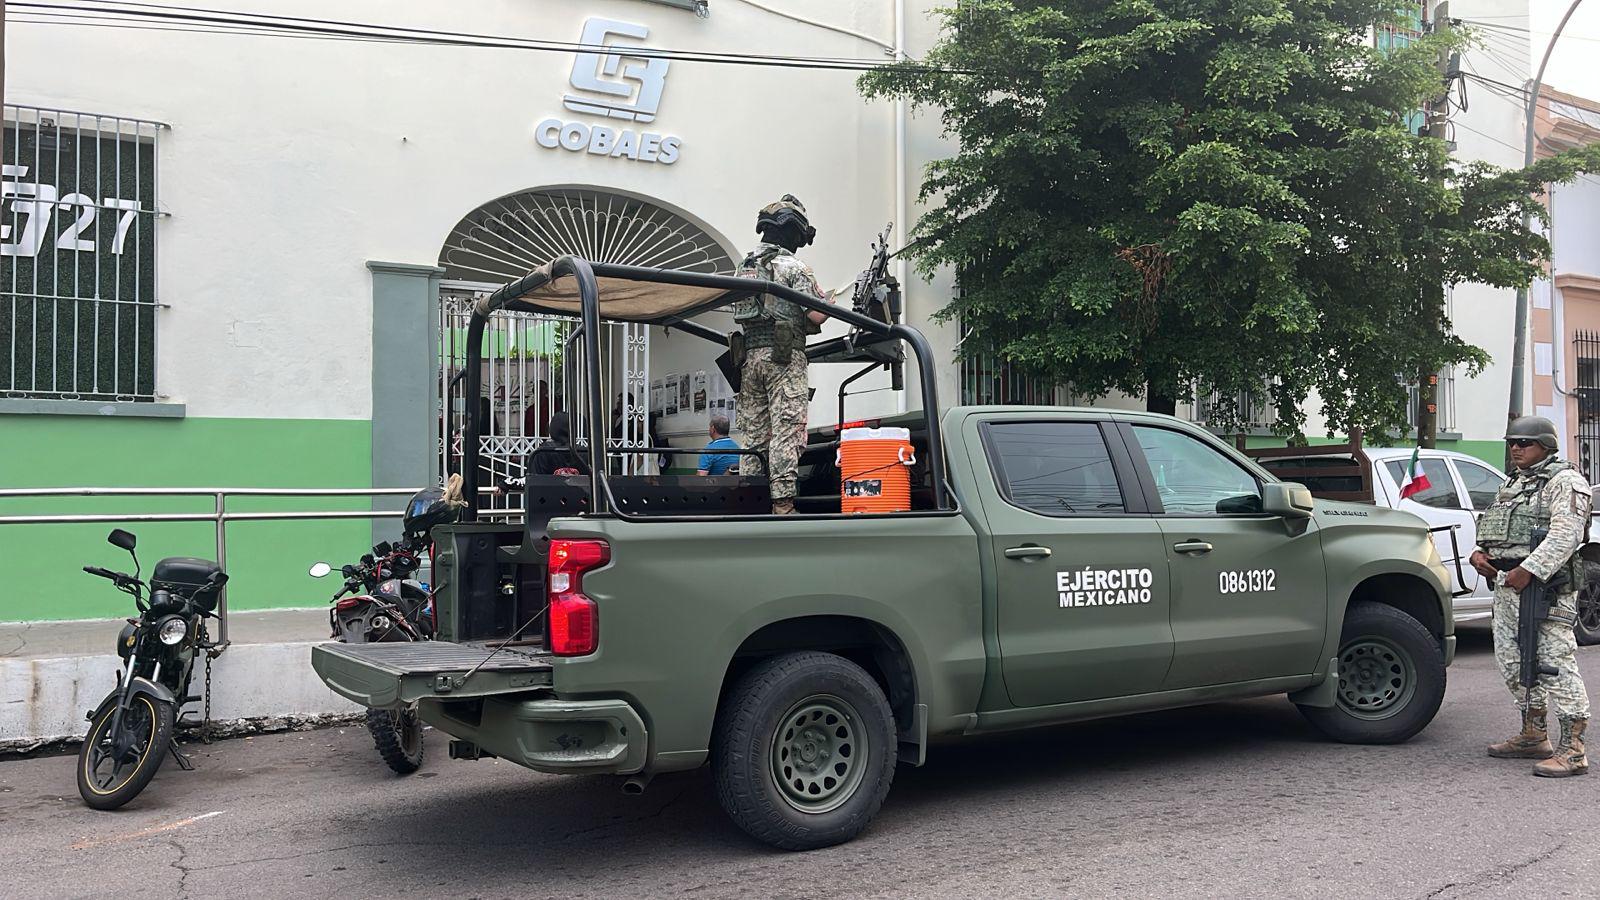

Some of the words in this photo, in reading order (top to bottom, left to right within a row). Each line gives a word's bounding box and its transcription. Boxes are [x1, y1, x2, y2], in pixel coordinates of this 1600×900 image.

[535, 118, 683, 165] COBAES
[1057, 566, 1153, 591] EJÉRCITO
[1219, 568, 1276, 594] 0861312
[1059, 588, 1151, 608] MEXICANO
